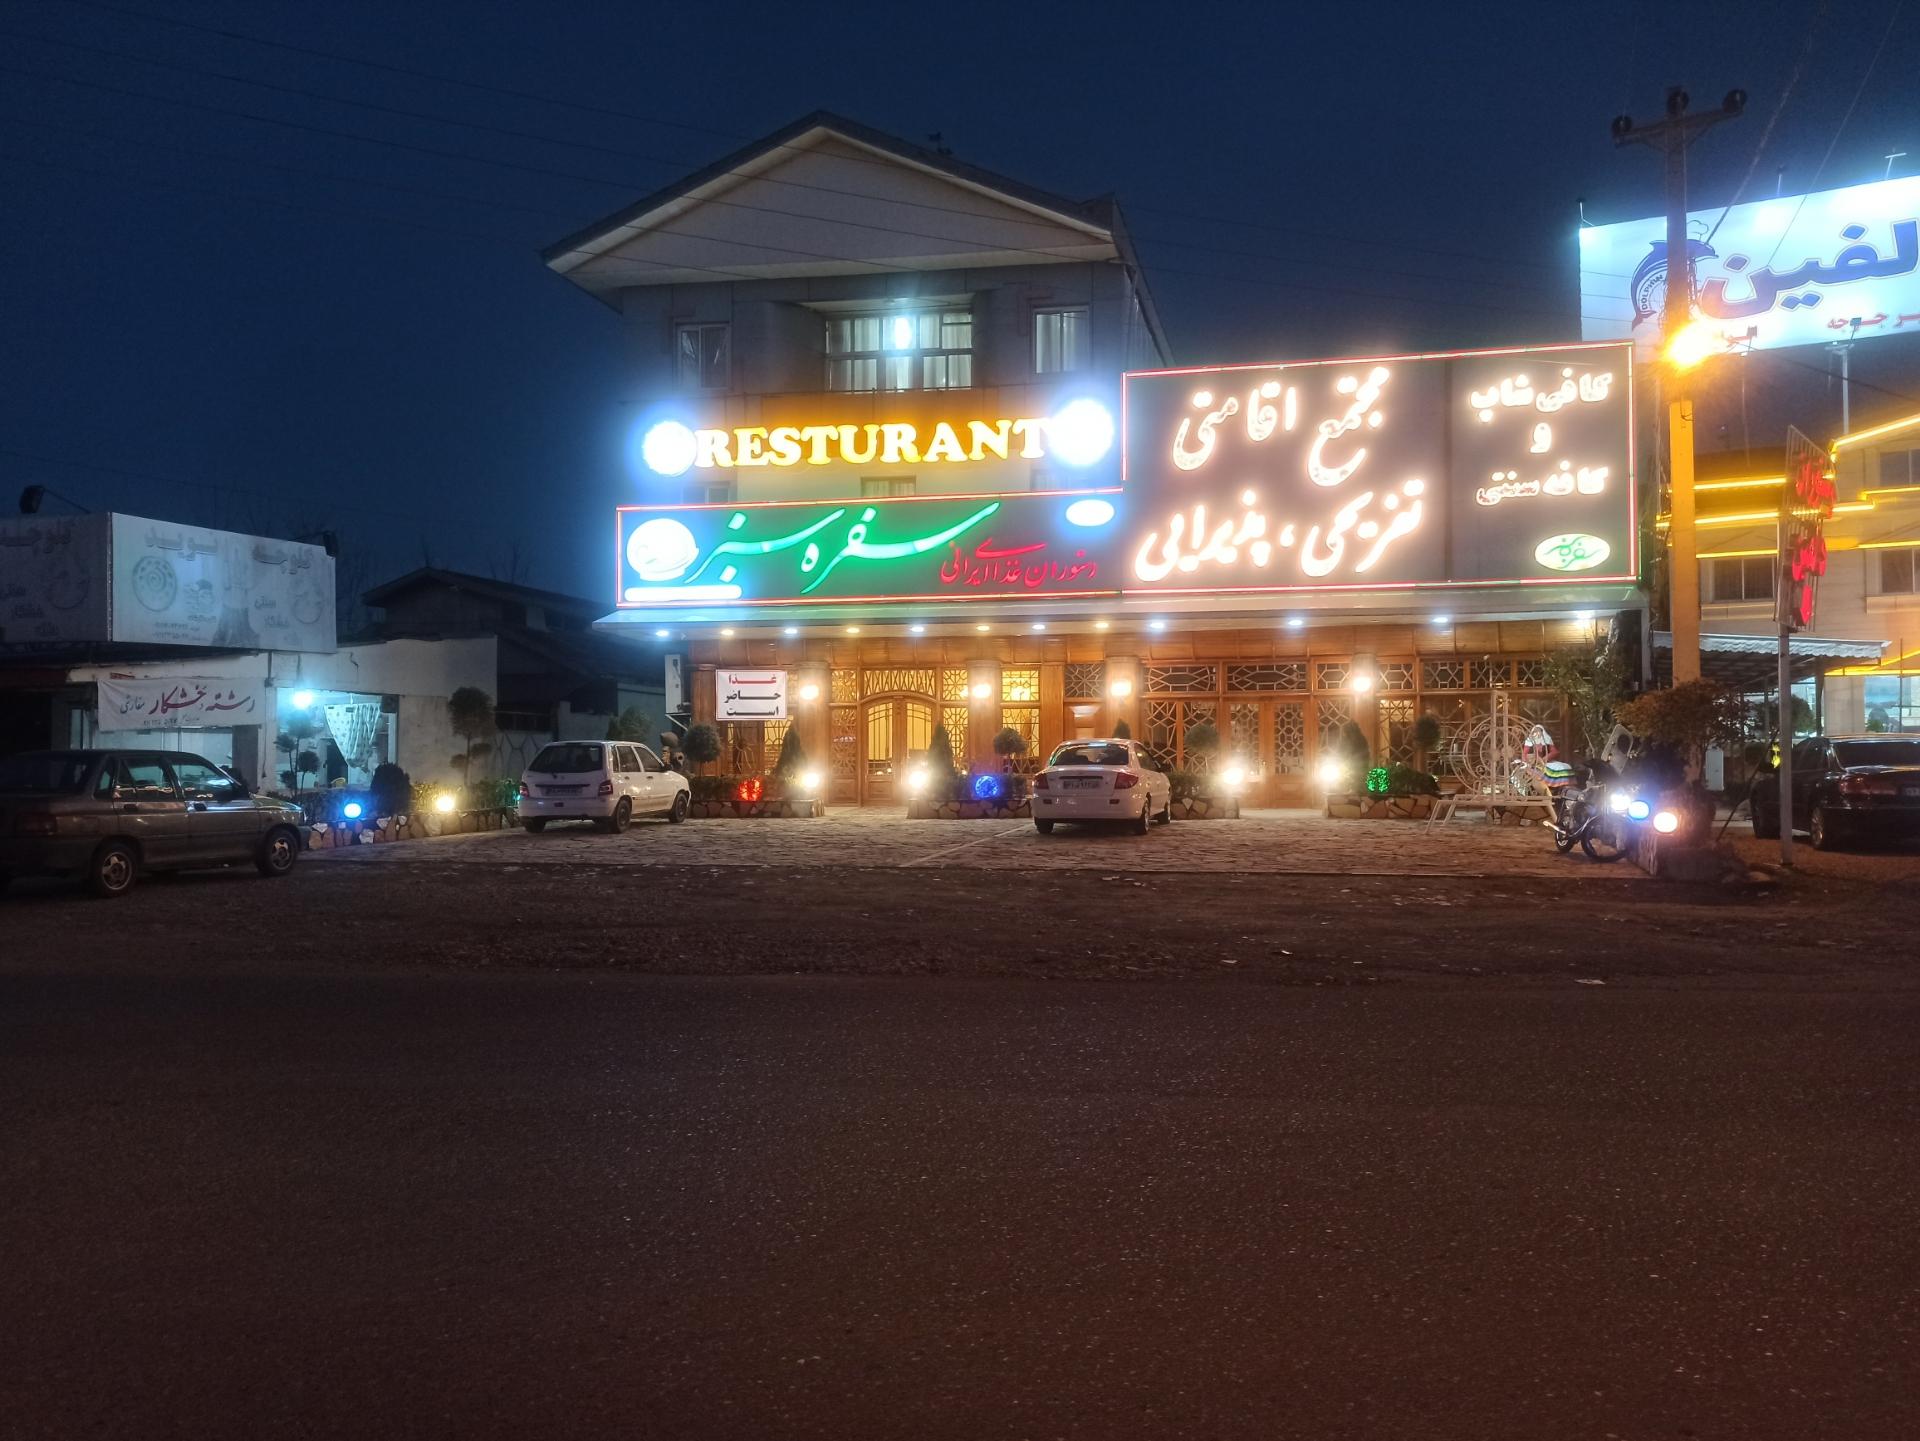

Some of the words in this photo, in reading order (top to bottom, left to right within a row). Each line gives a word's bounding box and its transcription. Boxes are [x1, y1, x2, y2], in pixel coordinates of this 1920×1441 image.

[1470, 374, 1534, 424] شاپ
[1536, 367, 1614, 412] کافی
[694, 416, 1050, 469] RESTURANT
[1172, 380, 1297, 472] اقامتی
[1529, 422, 1553, 453] و
[1475, 471, 1541, 507] سنتی
[1543, 460, 1610, 496] کافه
[684, 507, 846, 584] سبز
[801, 502, 1001, 595] سفره
[724, 689, 782, 704] حاضر
[728, 673, 777, 685] غذا
[148, 682, 206, 715] خشکار
[205, 690, 257, 713] رشته
[726, 705, 780, 717] است
